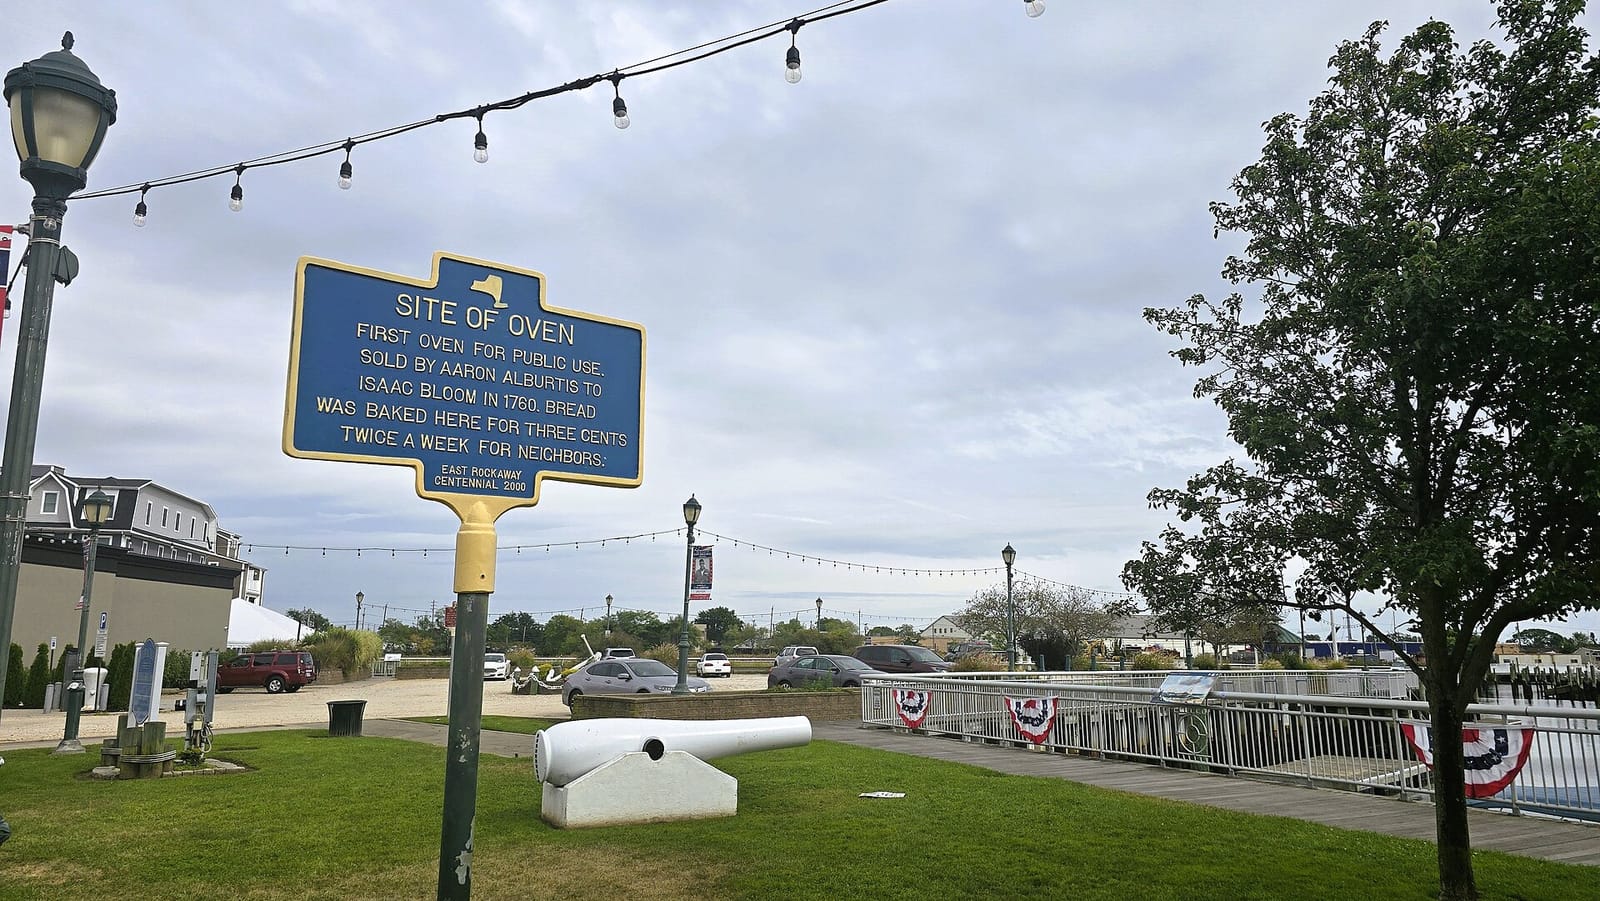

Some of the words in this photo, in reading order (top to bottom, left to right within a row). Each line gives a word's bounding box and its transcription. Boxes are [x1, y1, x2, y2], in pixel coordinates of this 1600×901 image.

[395, 293, 458, 325] SITE
[466, 306, 499, 331] OF
[508, 314, 575, 345] OVEN
[357, 322, 411, 345] FIRST
[419, 333, 464, 354] OVEN
[473, 342, 505, 361] FOR
[513, 349, 567, 371] PUBLIC
[572, 359, 605, 377] USE.
[360, 348, 407, 369] SOLD
[414, 356, 436, 373] BY
[439, 361, 496, 382] AARON
[502, 370, 579, 394] ALBURTIS
[583, 381, 602, 397] TO
[359, 375, 413, 396] ISAAC
[420, 382, 477, 404] BLOOM
[483, 391, 498, 407] IN
[503, 394, 540, 412] 1760.
[545, 400, 596, 419] BREAD
[316, 396, 356, 415] WAS
[366, 402, 427, 424] BAKED
[434, 409, 482, 430] HERE
[487, 416, 519, 435] FOR
[525, 422, 576, 441] THREE
[580, 428, 628, 447] CENTS
[340, 425, 399, 446] TWICE
[403, 432, 415, 448] A
[420, 433, 470, 453] WEEK
[479, 439, 511, 457] FOR
[434, 475, 499, 490] CENTENNIAL
[503, 481, 526, 492] 2000
[441, 464, 468, 475] EAST
[471, 466, 522, 480] ROCKAWAY
